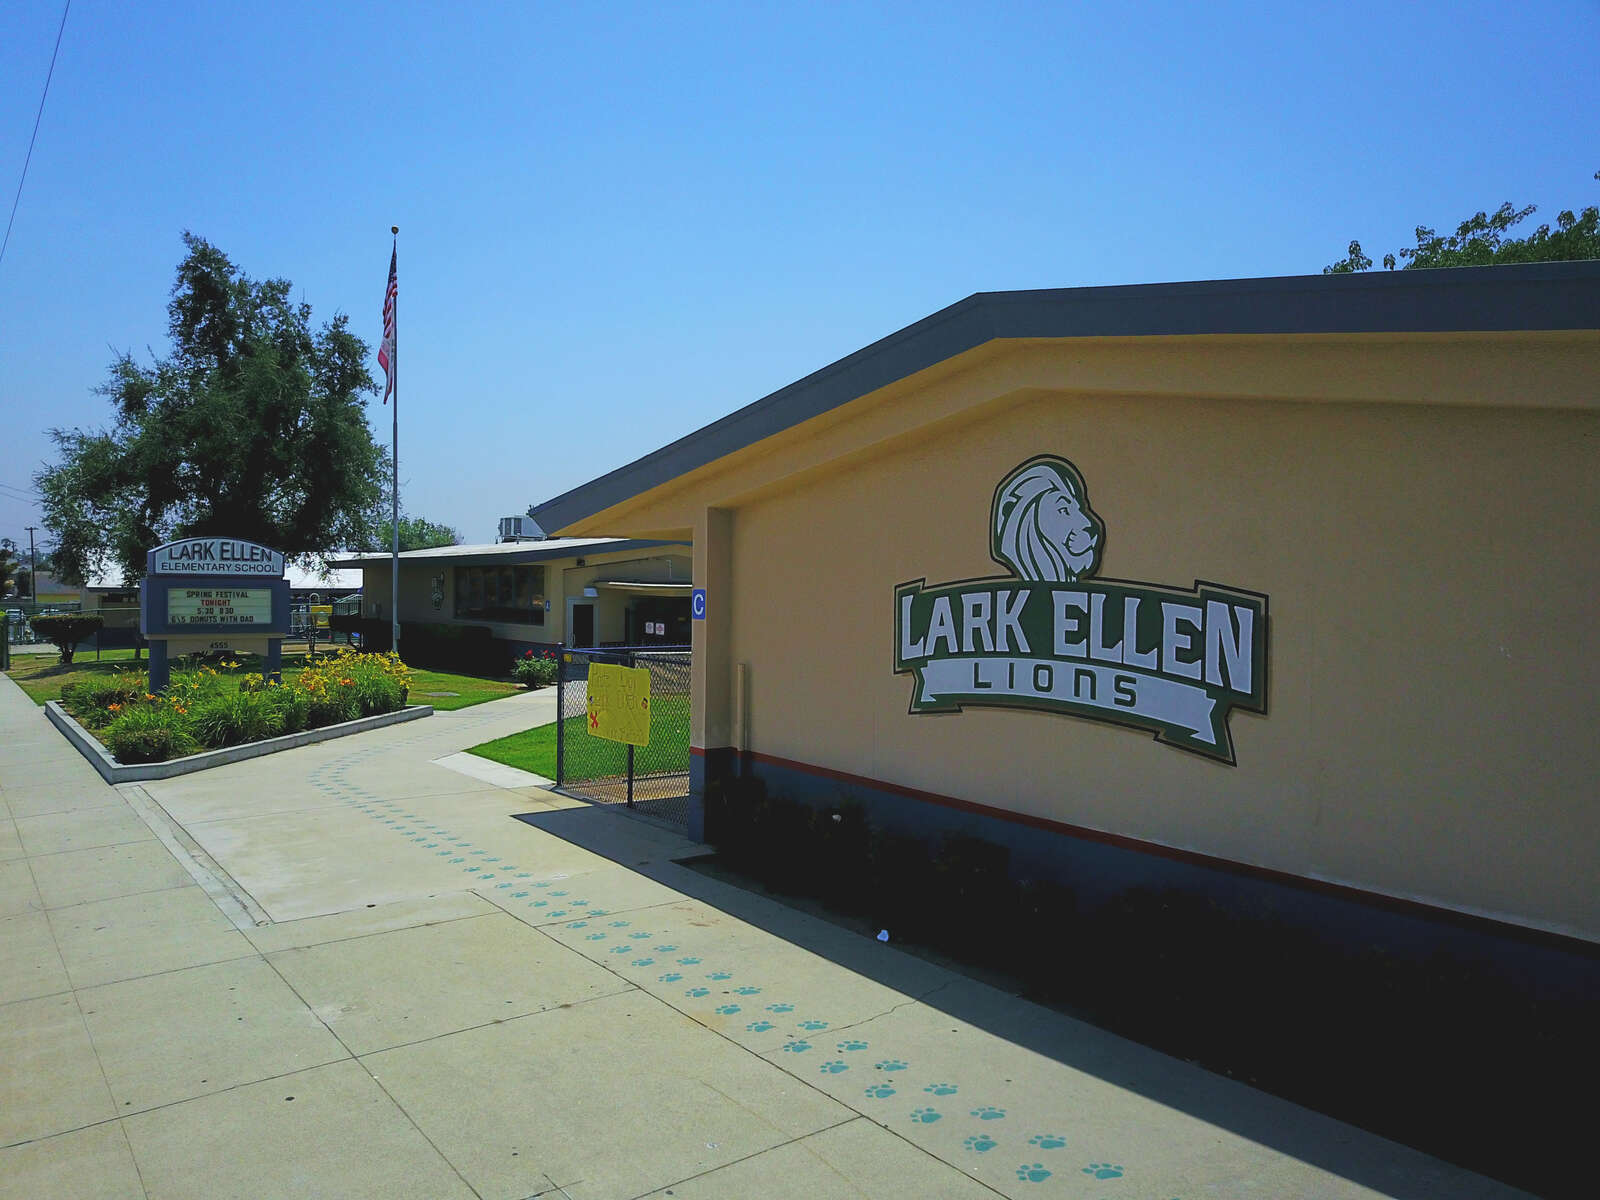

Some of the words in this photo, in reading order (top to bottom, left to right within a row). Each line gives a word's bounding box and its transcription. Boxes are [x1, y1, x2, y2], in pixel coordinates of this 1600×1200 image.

[169, 542, 215, 561] LARK
[221, 542, 272, 562] ELLEN
[161, 562, 232, 572] ELEMENTARY
[234, 564, 278, 573] SCHOOL
[694, 594, 704, 616] C
[901, 589, 1031, 661] LARK
[1052, 590, 1254, 695] ELLEN
